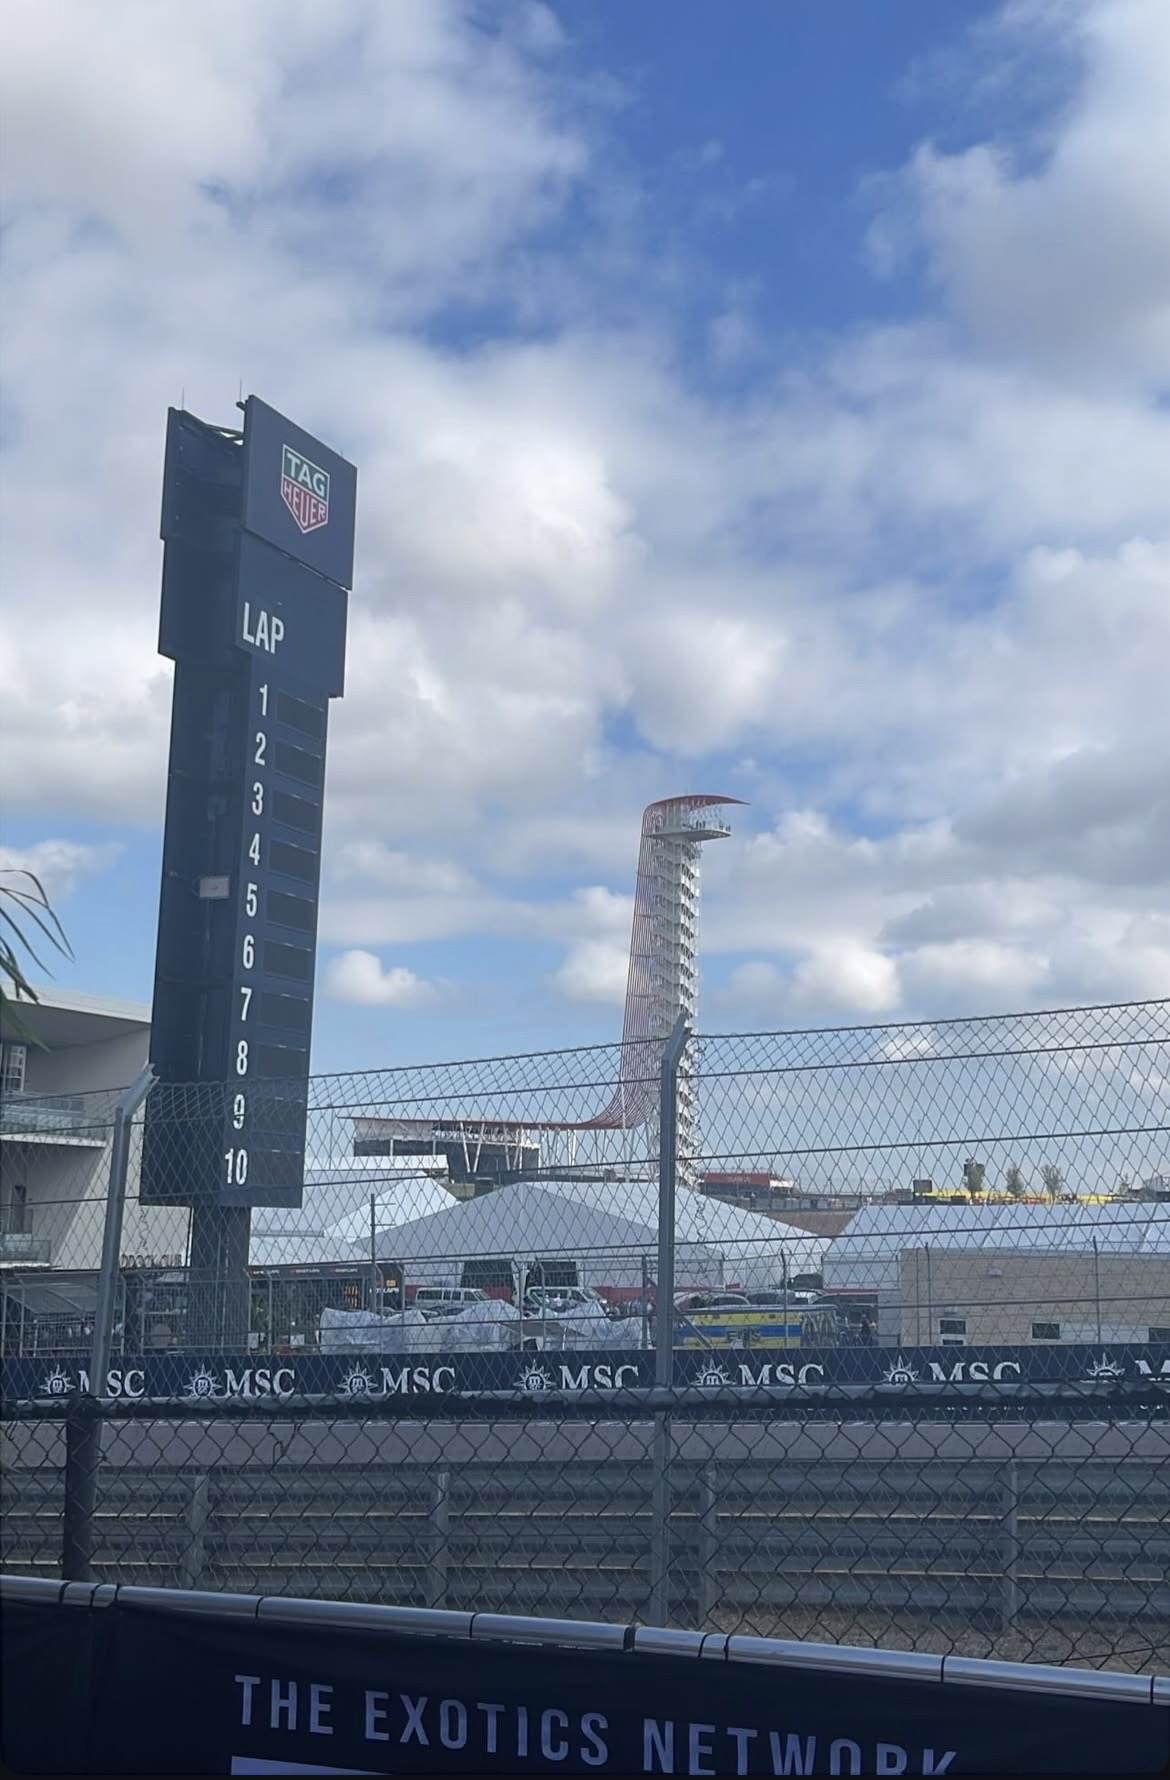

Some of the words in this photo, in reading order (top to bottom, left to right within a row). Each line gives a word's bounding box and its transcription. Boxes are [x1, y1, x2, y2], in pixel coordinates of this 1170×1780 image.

[286, 451, 326, 498] TAG
[284, 480, 326, 527] HEUER
[243, 602, 284, 653] LAP
[259, 684, 268, 717] 1
[255, 732, 265, 765] 2
[252, 782, 263, 815] 3
[249, 833, 260, 866] 4
[246, 883, 257, 917] 5
[243, 935, 254, 969] 6
[240, 987, 252, 1021] 7
[236, 1040, 248, 1075] 8
[233, 1094, 245, 1130] 9
[224, 1148, 248, 1185] 10
[225, 1369, 295, 1397] MSC
[381, 1367, 455, 1394] MSC
[559, 1365, 639, 1389] MSC
[738, 1364, 824, 1385] MSC
[235, 1675, 334, 1735] THE
[365, 1690, 609, 1766] EXOTICS
